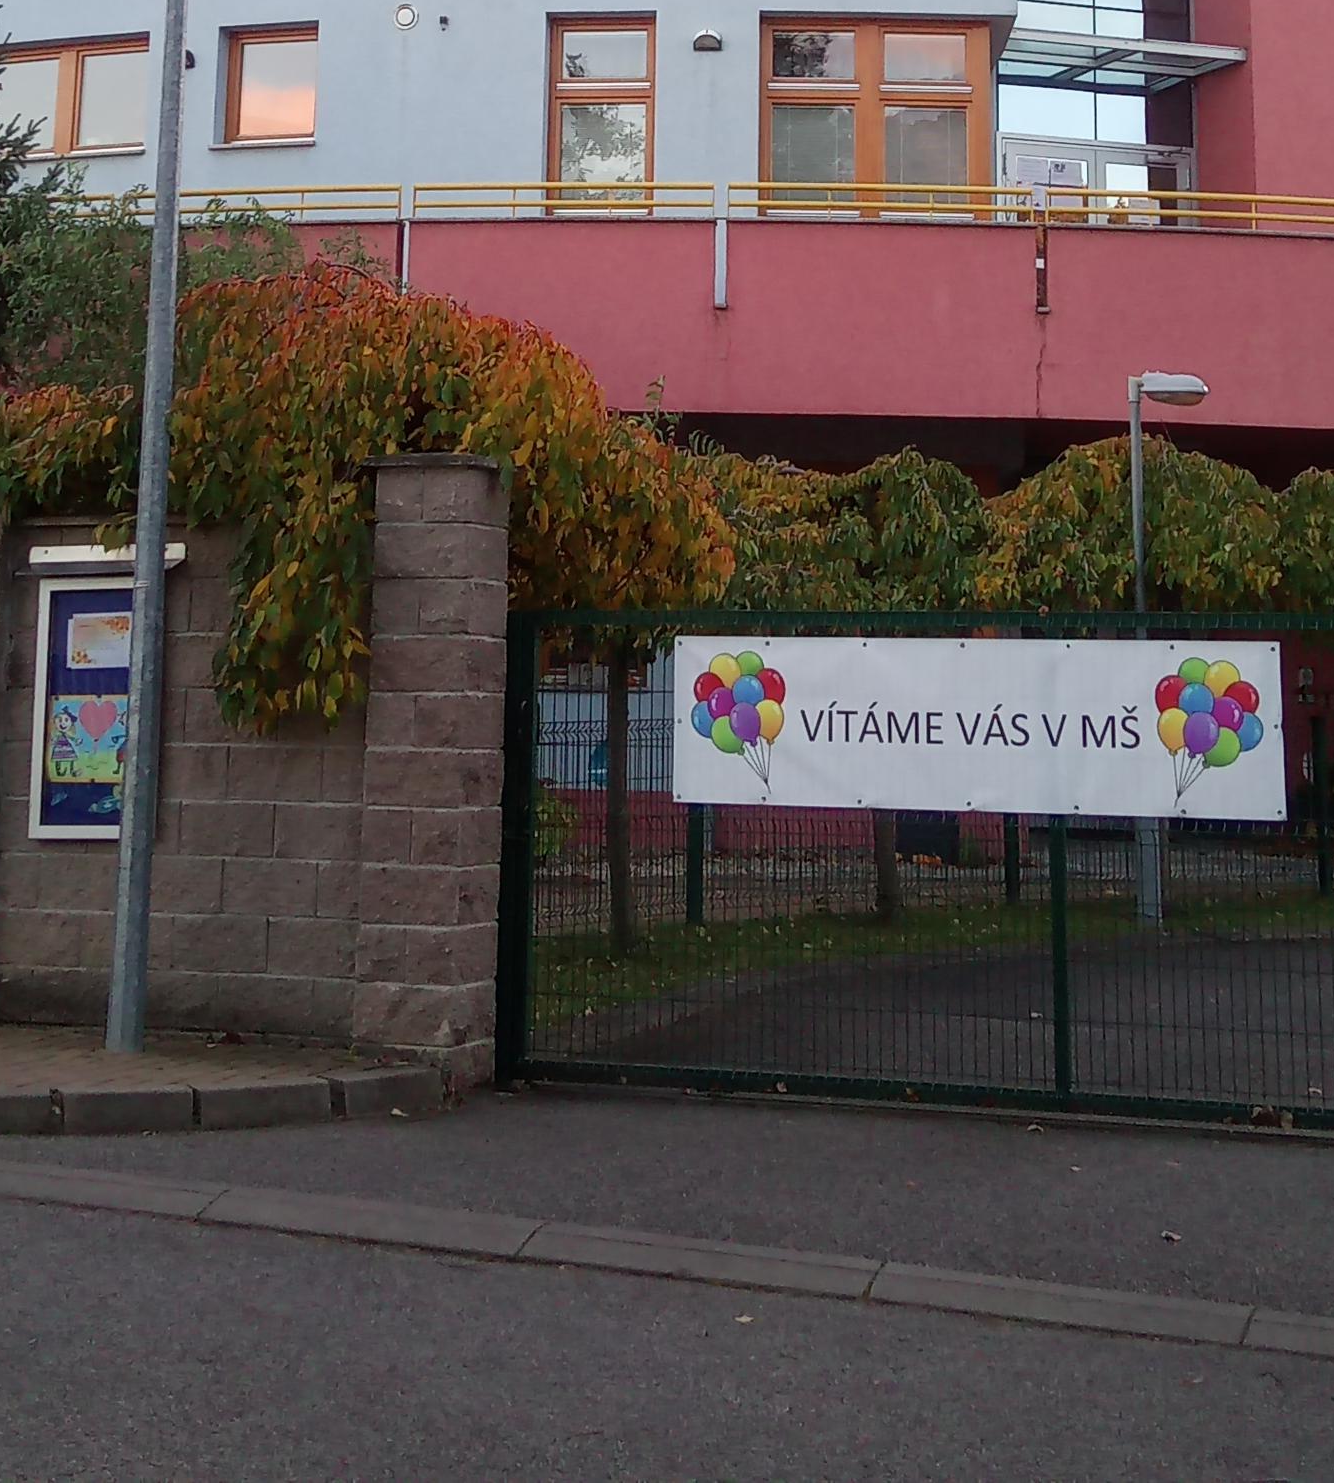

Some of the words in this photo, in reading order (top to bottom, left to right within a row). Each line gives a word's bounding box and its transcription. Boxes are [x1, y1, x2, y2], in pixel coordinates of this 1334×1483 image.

[800, 700, 944, 745] VÍTÁME
[956, 703, 1030, 747] VÁS
[1041, 713, 1068, 748] V
[1081, 705, 1141, 750] MŠ
